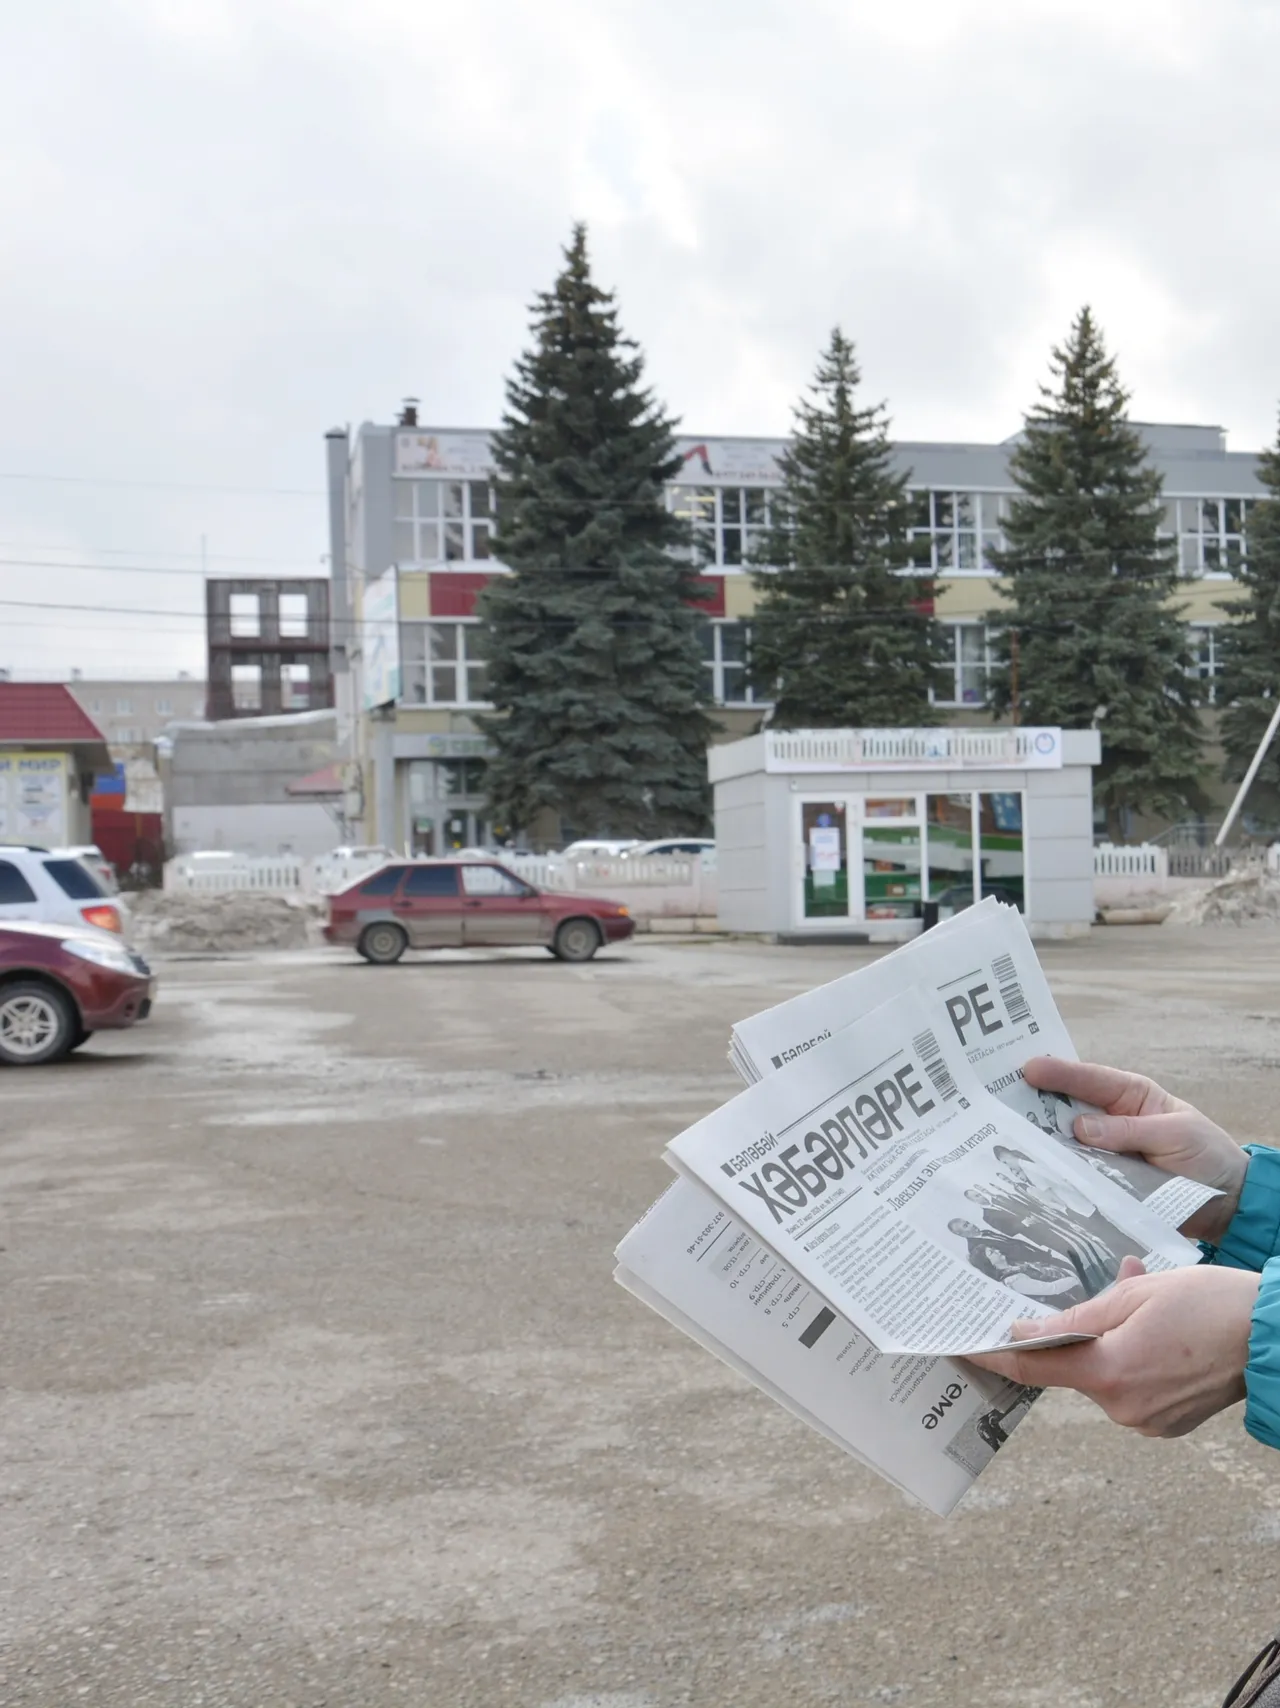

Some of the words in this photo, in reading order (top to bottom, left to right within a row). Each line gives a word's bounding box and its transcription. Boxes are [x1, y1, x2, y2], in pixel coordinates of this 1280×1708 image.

[943, 981, 1004, 1047] РЕ
[737, 1062, 936, 1225] ХӘБӘРЛӘРЕ
[885, 1173, 928, 1212] Лаеклы
[963, 1120, 999, 1149] итәләр
[735, 1261, 751, 1280] стр.
[728, 1277, 739, 1290] 10
[751, 1271, 782, 1307] традиции
[747, 1292, 755, 1301] 9
[767, 1291, 784, 1309] стр.
[763, 1307, 772, 1316] 8
[784, 1304, 801, 1322] стр.
[780, 1320, 789, 1329] 5
[834, 1337, 857, 1362] Алины
